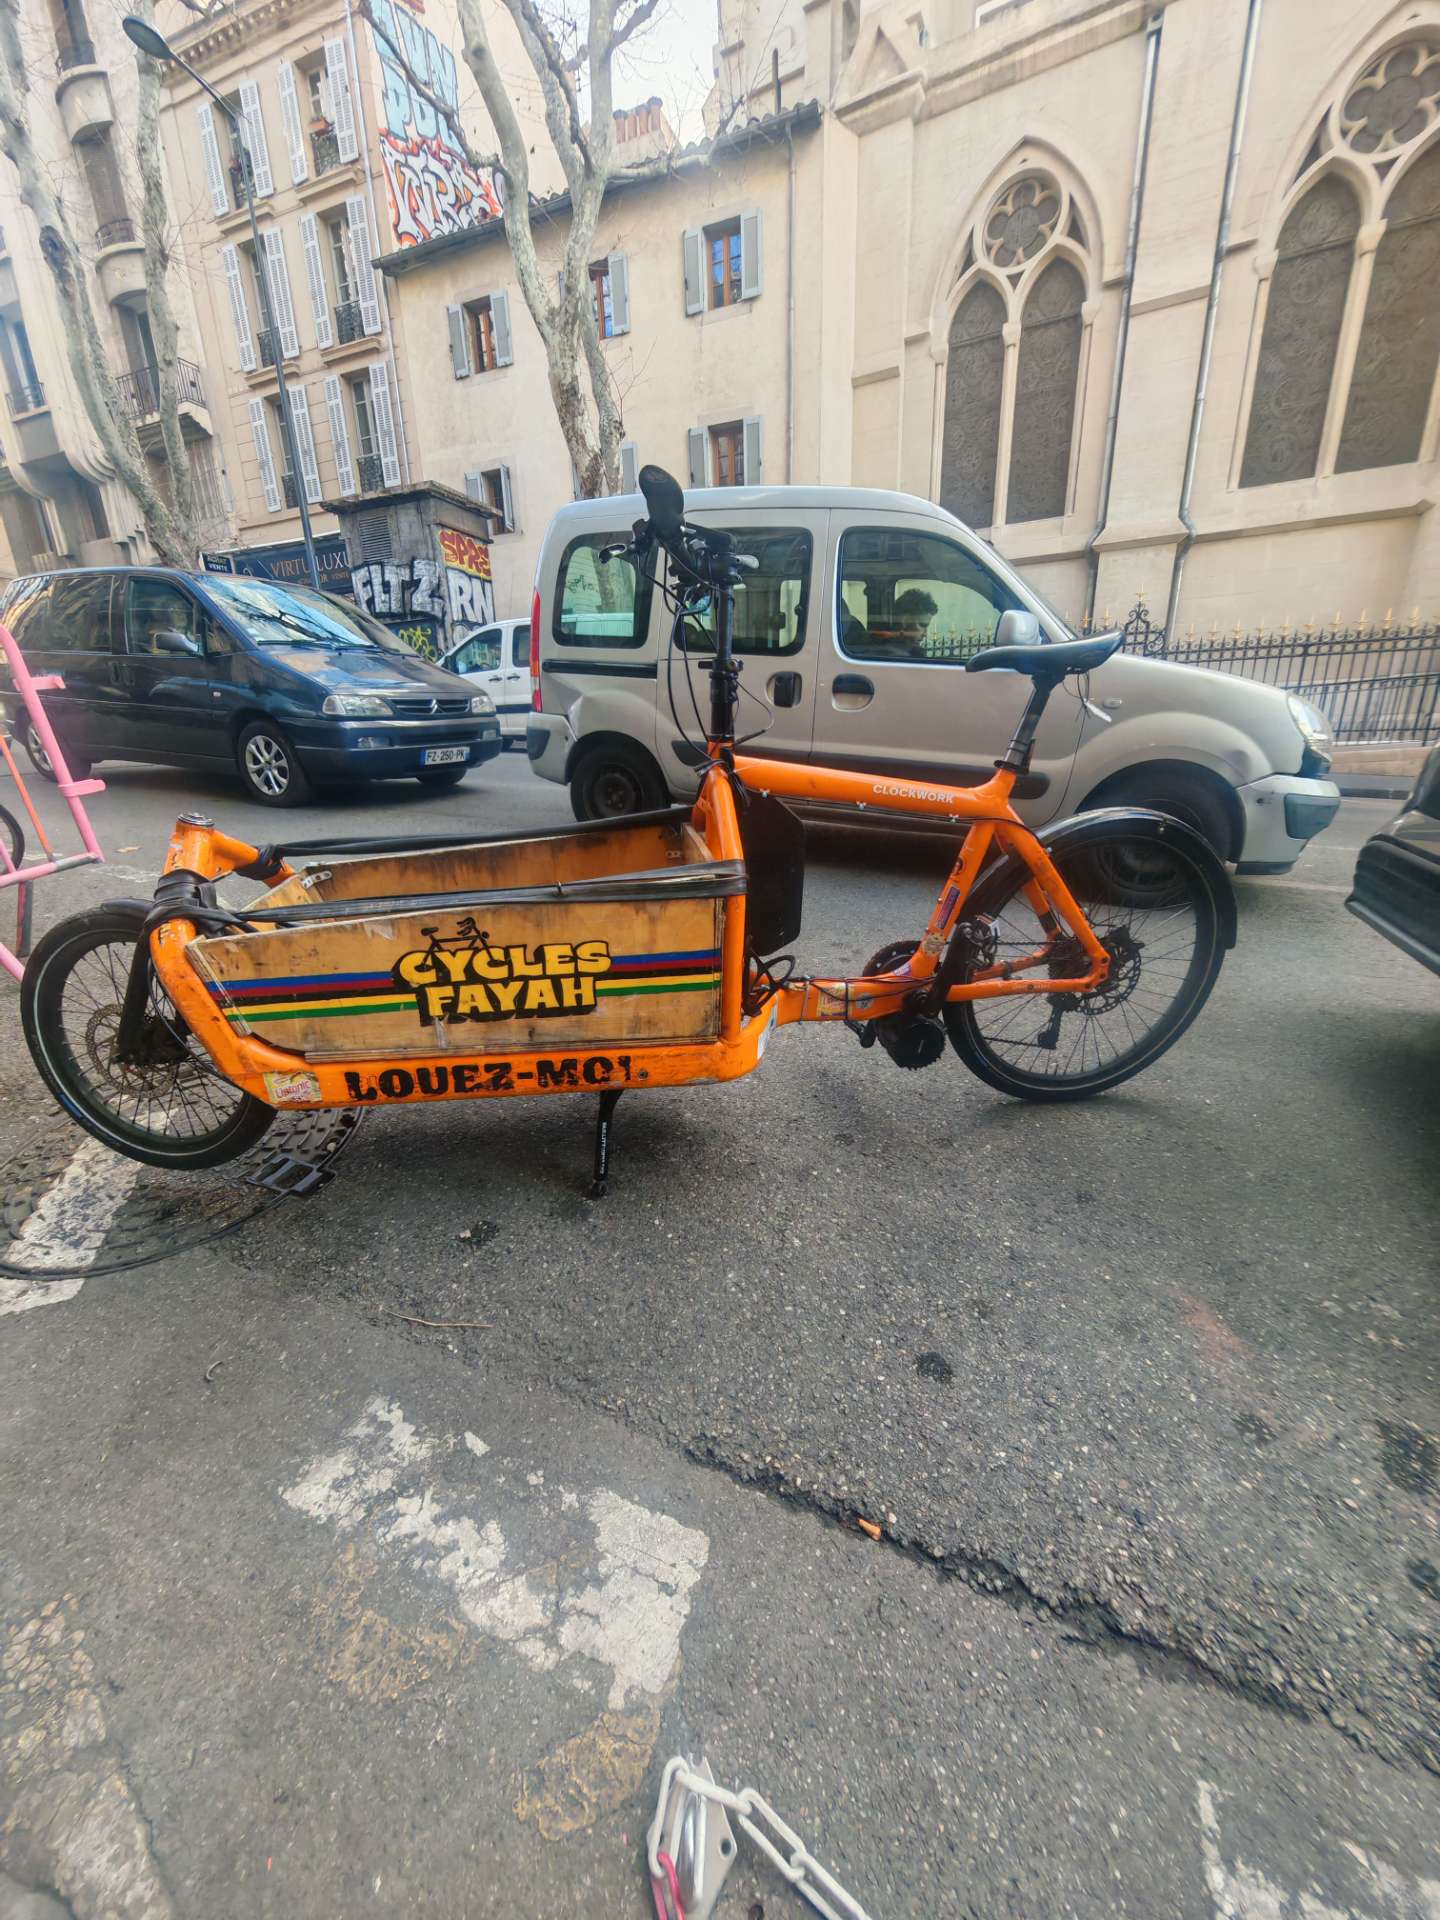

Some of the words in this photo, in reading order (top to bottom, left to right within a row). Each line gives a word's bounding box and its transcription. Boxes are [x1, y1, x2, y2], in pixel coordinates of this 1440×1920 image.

[873, 784, 955, 804] CLOCKWORK
[397, 940, 613, 986] CYCLES
[422, 976, 597, 1022] FAYAH
